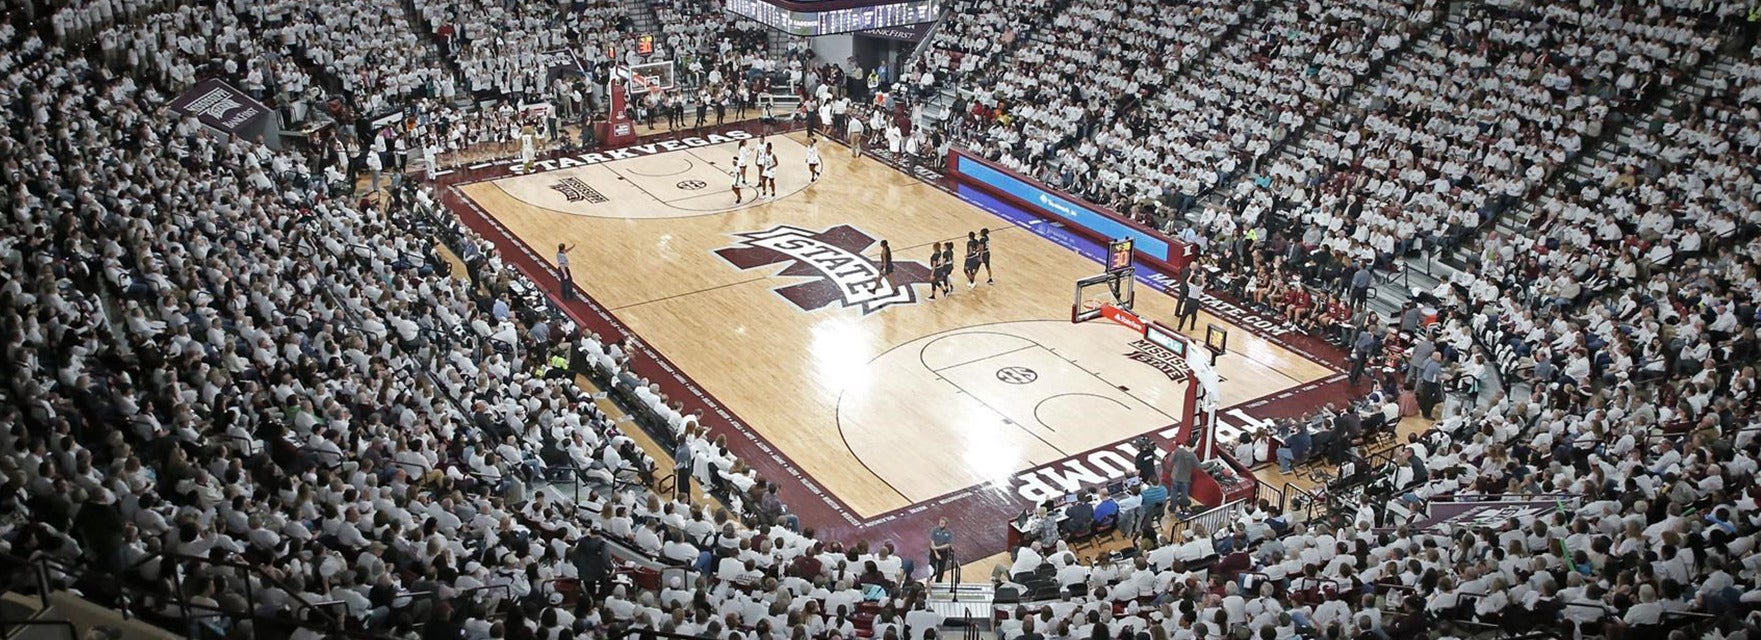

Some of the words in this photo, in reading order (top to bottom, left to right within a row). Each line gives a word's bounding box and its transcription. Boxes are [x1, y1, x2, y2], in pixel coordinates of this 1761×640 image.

[864, 27, 915, 39] ANKFIRST
[508, 130, 753, 176] STARKVEGAS
[773, 238, 885, 296] STATE
[1111, 250, 1129, 268] 30
